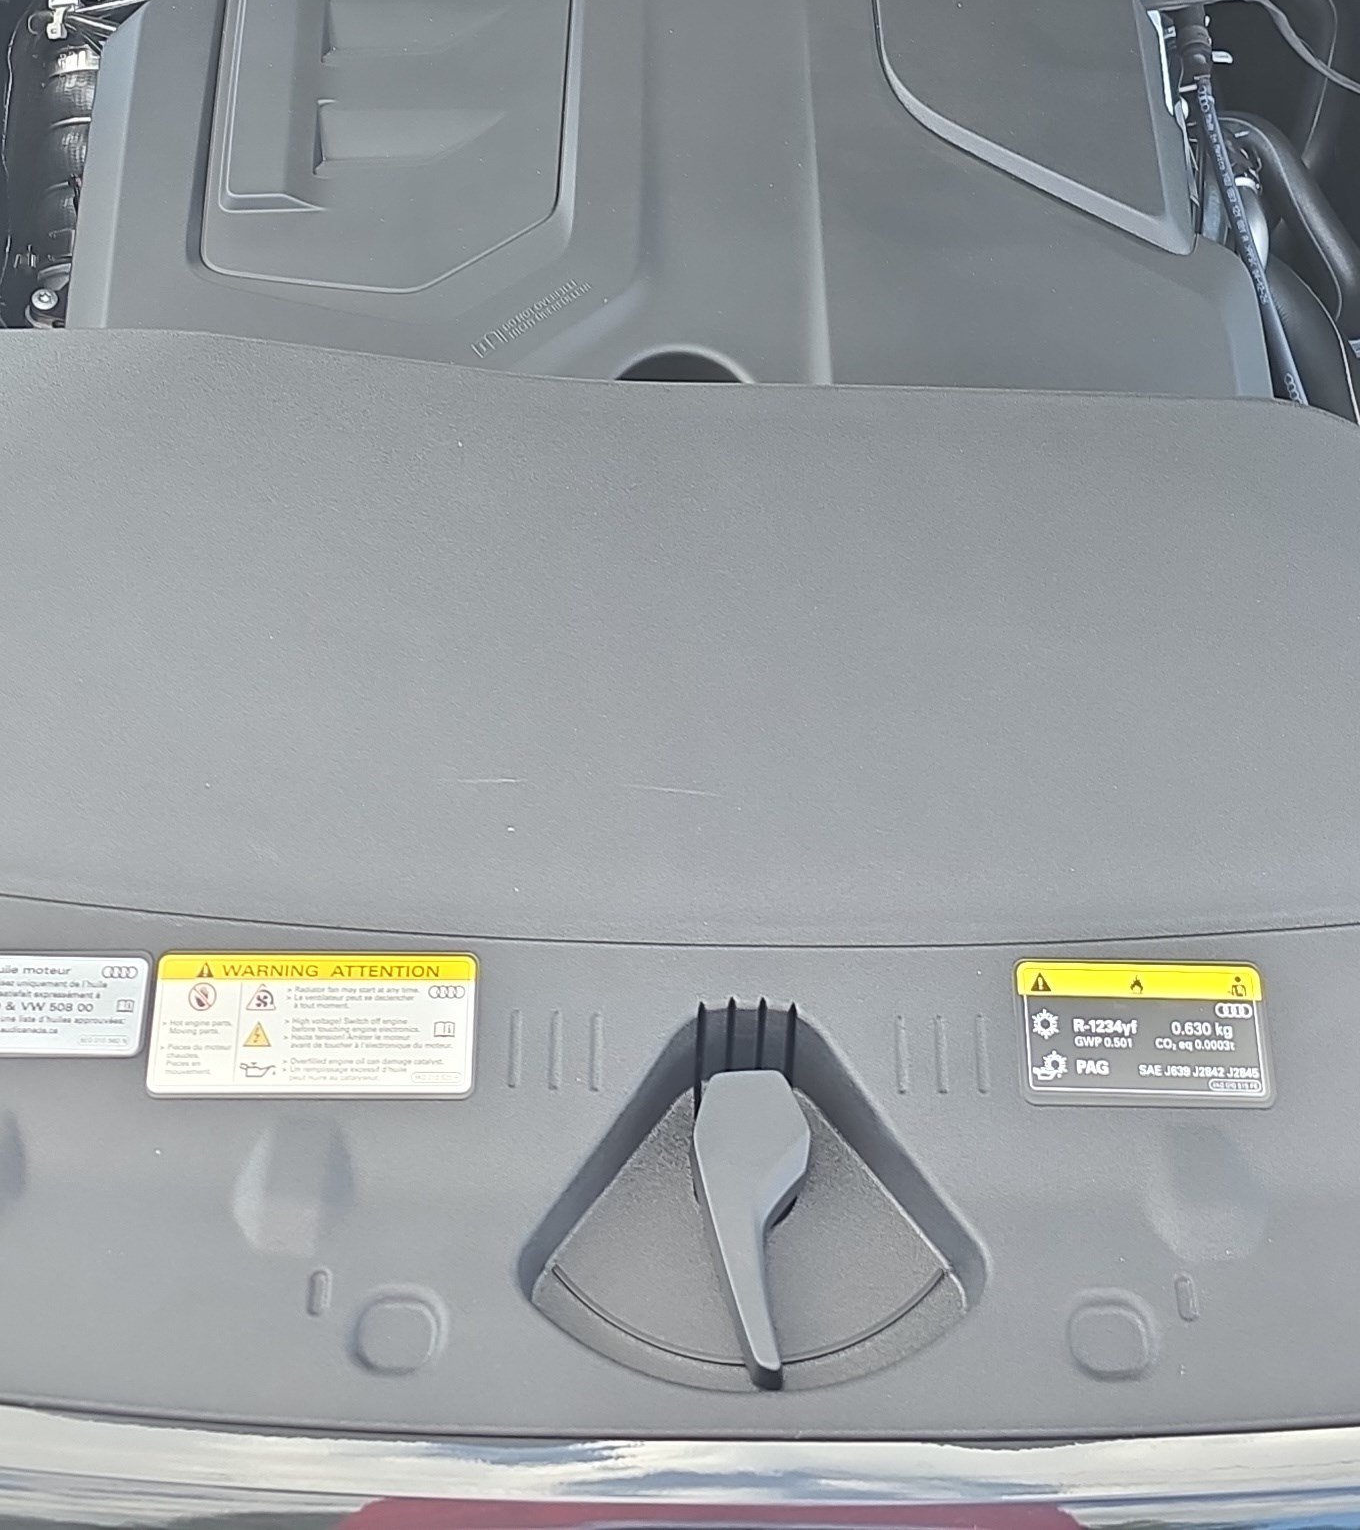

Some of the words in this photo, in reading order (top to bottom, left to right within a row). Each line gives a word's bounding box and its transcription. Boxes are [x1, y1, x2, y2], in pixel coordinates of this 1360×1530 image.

[23, 967, 71, 975] moteur
[222, 965, 318, 977] WARNING
[330, 966, 439, 977] ATTENTION
[5, 1002, 15, 1010] &
[21, 1002, 45, 1011] VW
[49, 1003, 73, 1012] 508
[78, 1003, 93, 1012] 00
[1073, 1019, 1138, 1036] R-1234yf
[1171, 1022, 1211, 1036] 0.630
[1215, 1022, 1232, 1039] kg
[1075, 1037, 1102, 1047] GWP
[1104, 1038, 1132, 1048] 0.501
[1179, 1041, 1193, 1051] eq
[1195, 1040, 1235, 1051] 0.0003t
[1077, 1060, 1110, 1075] PAG
[1139, 1063, 1161, 1076] SAE
[1165, 1064, 1190, 1077] J639
[1193, 1065, 1224, 1078] J2842
[1227, 1066, 1259, 1079] J2845
